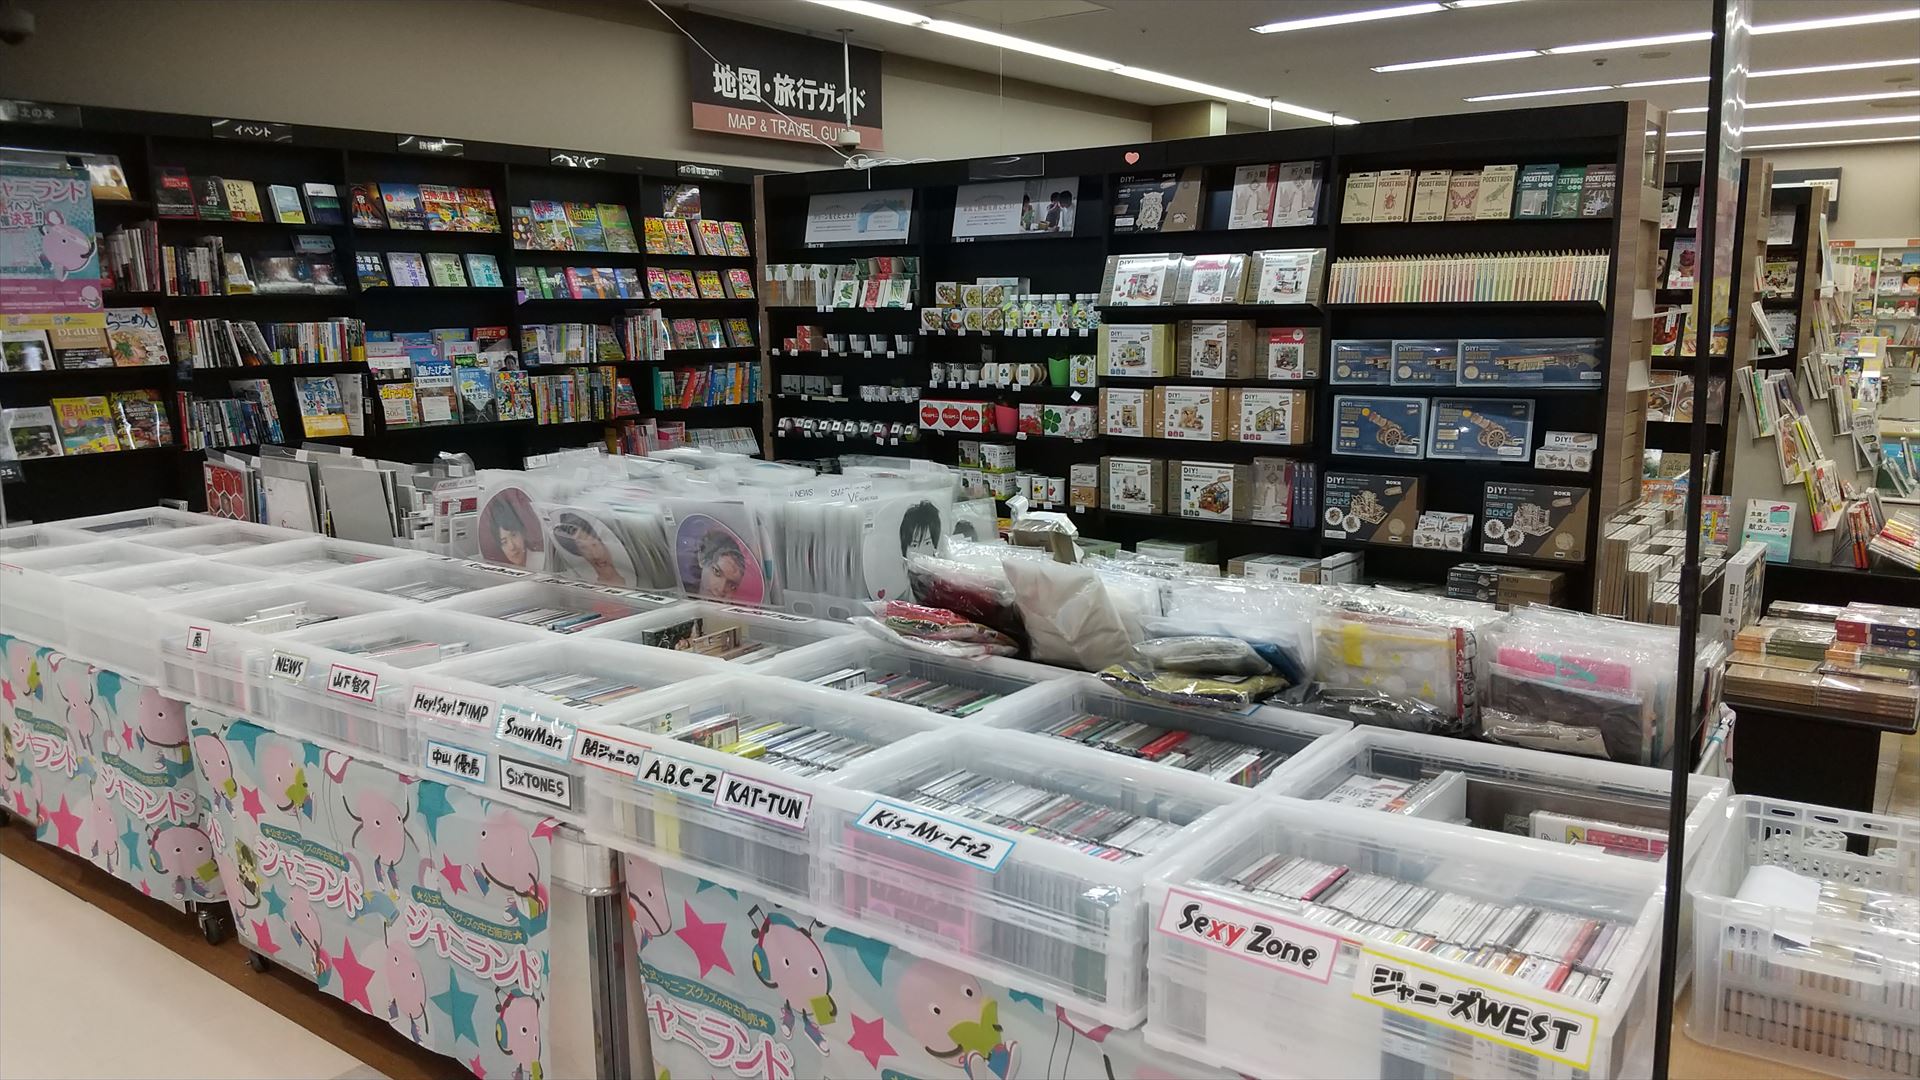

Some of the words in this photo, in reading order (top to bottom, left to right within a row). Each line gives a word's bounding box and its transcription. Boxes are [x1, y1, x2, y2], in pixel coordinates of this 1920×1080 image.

[712, 63, 867, 117] 地図・旅行ガイド
[9, 104, 56, 120] 土の本
[234, 124, 272, 138] イベント
[728, 112, 756, 131] MAP
[760, 120, 768, 132] &
[770, 118, 815, 139] TRAVEL
[820, 126, 861, 142] GUI
[106, 312, 157, 331] らーめん
[1554, 435, 1572, 444] DIY!
[794, 488, 814, 498] NEWS
[1326, 476, 1345, 485] DIY!
[1487, 486, 1507, 495] DIY!
[192, 632, 202, 648] 嵐
[275, 655, 304, 678] NEWS
[333, 672, 370, 695] 山下智久
[506, 767, 565, 798] SixTONES
[644, 759, 717, 794] A.B.C-Z
[724, 780, 802, 820] KAT-TUN
[868, 810, 992, 860] Kis-My-Ft2
[256, 840, 362, 914] ジャニランド
[406, 903, 540, 990] ジャニランド
[1178, 902, 1247, 948] Sexy
[1247, 924, 1318, 969] Zone
[1371, 966, 1580, 1051] ジャニーズWEST
